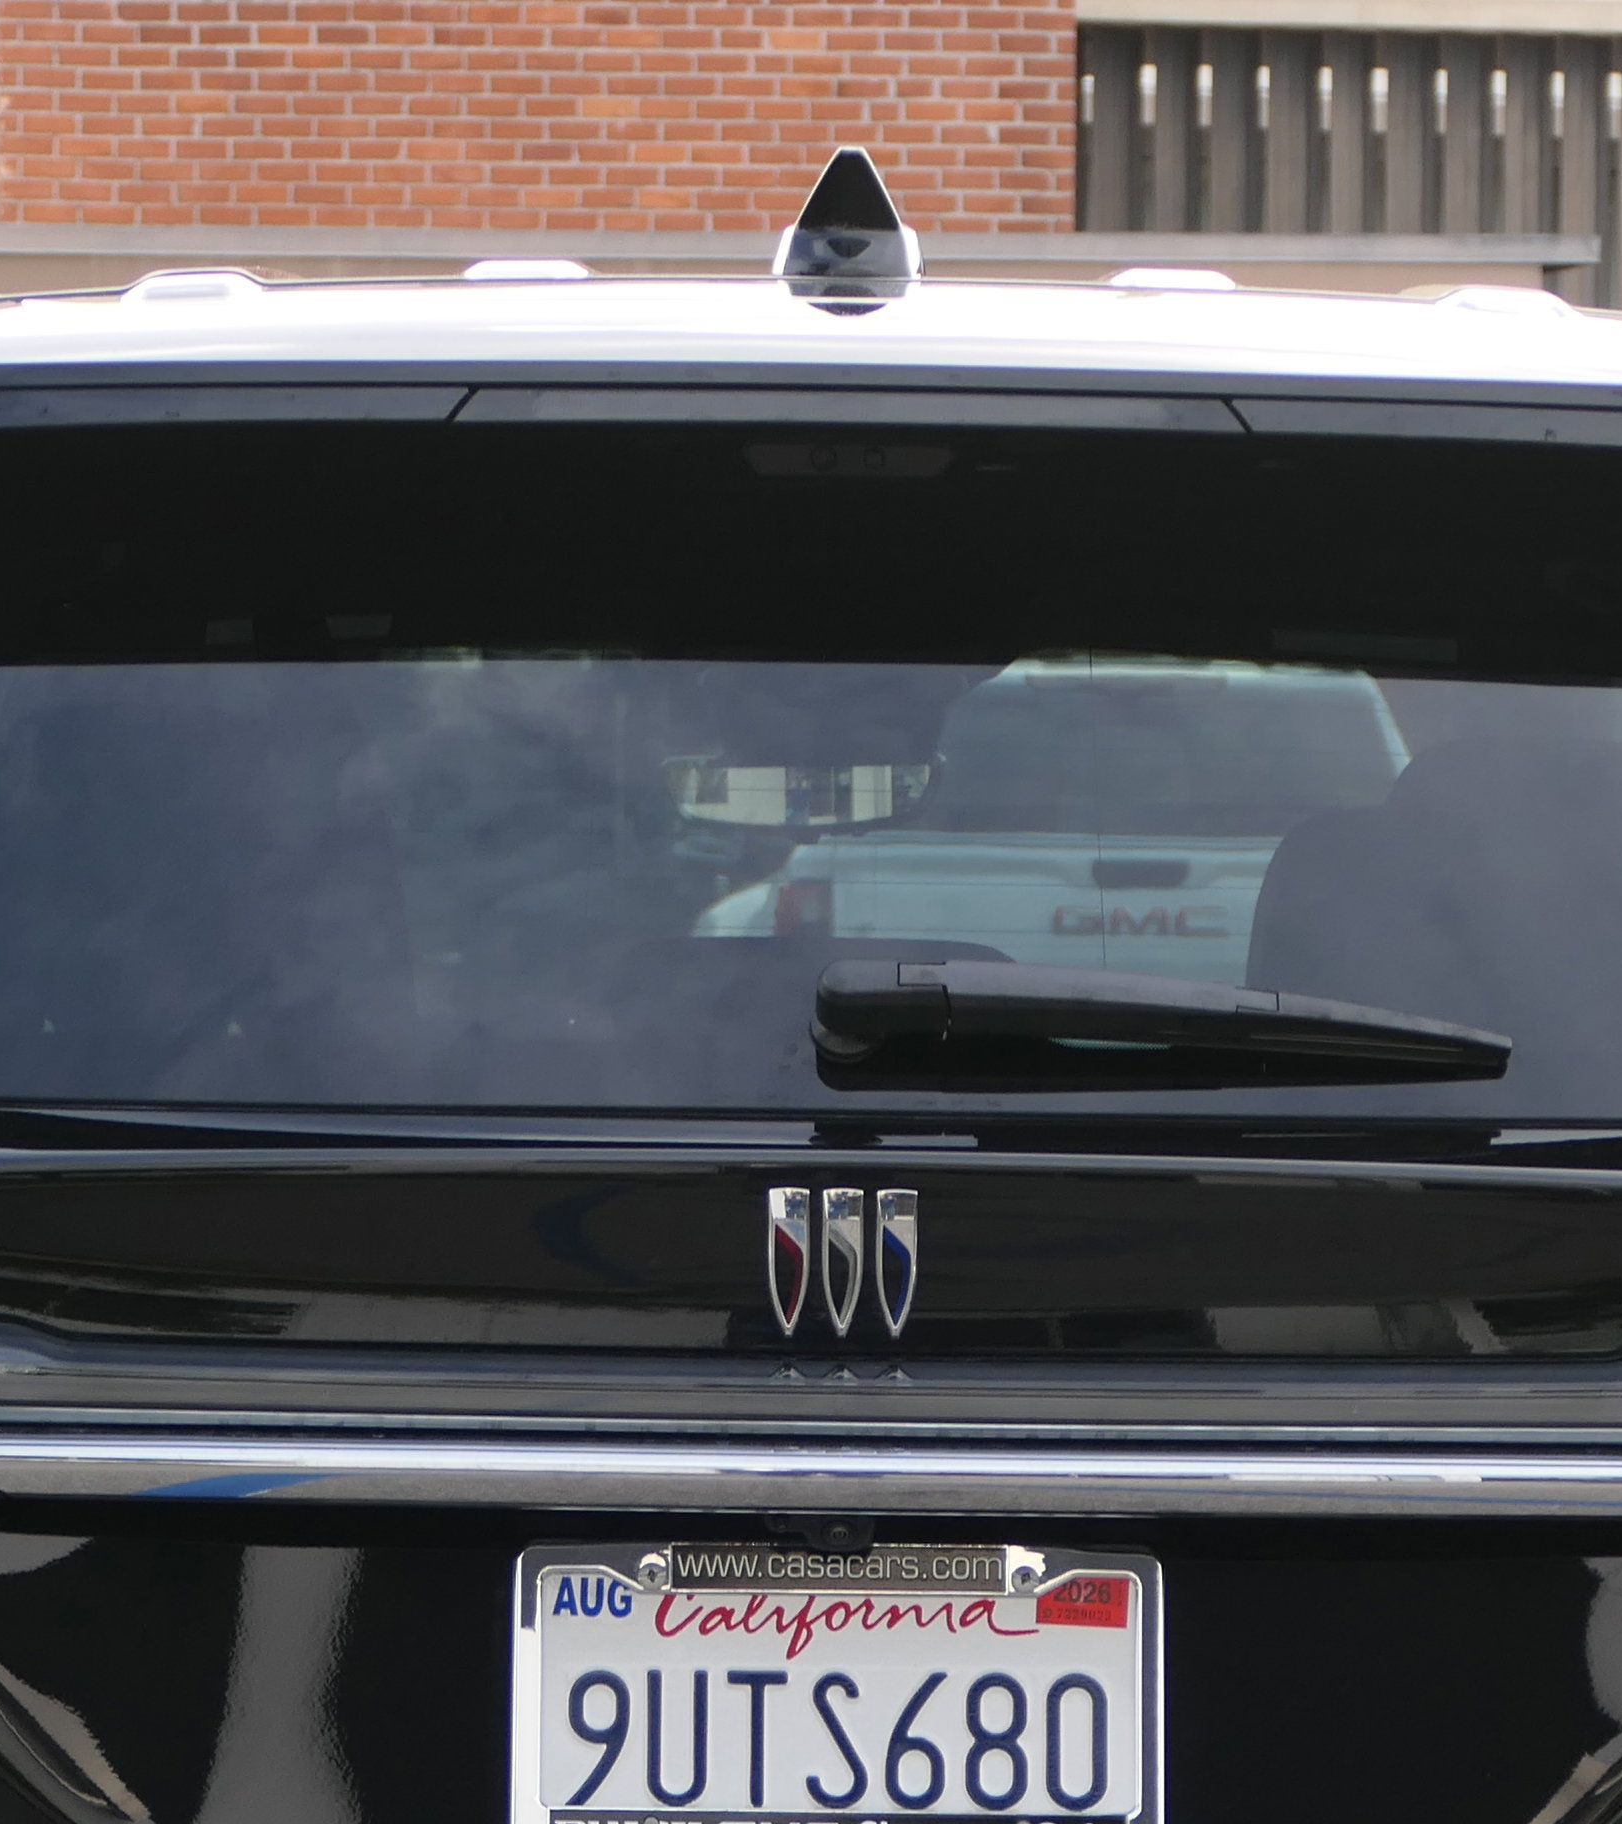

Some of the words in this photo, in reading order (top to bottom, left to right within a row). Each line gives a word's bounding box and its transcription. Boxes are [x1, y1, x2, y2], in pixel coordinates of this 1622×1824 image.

[1052, 905, 1228, 938] GMC
[677, 1553, 1003, 1581] www.casacars.com
[552, 1575, 633, 1618] AUG
[1053, 1580, 1113, 1604] 2026
[654, 1593, 1040, 1661] California
[564, 1668, 1109, 1811] 9UTS680
